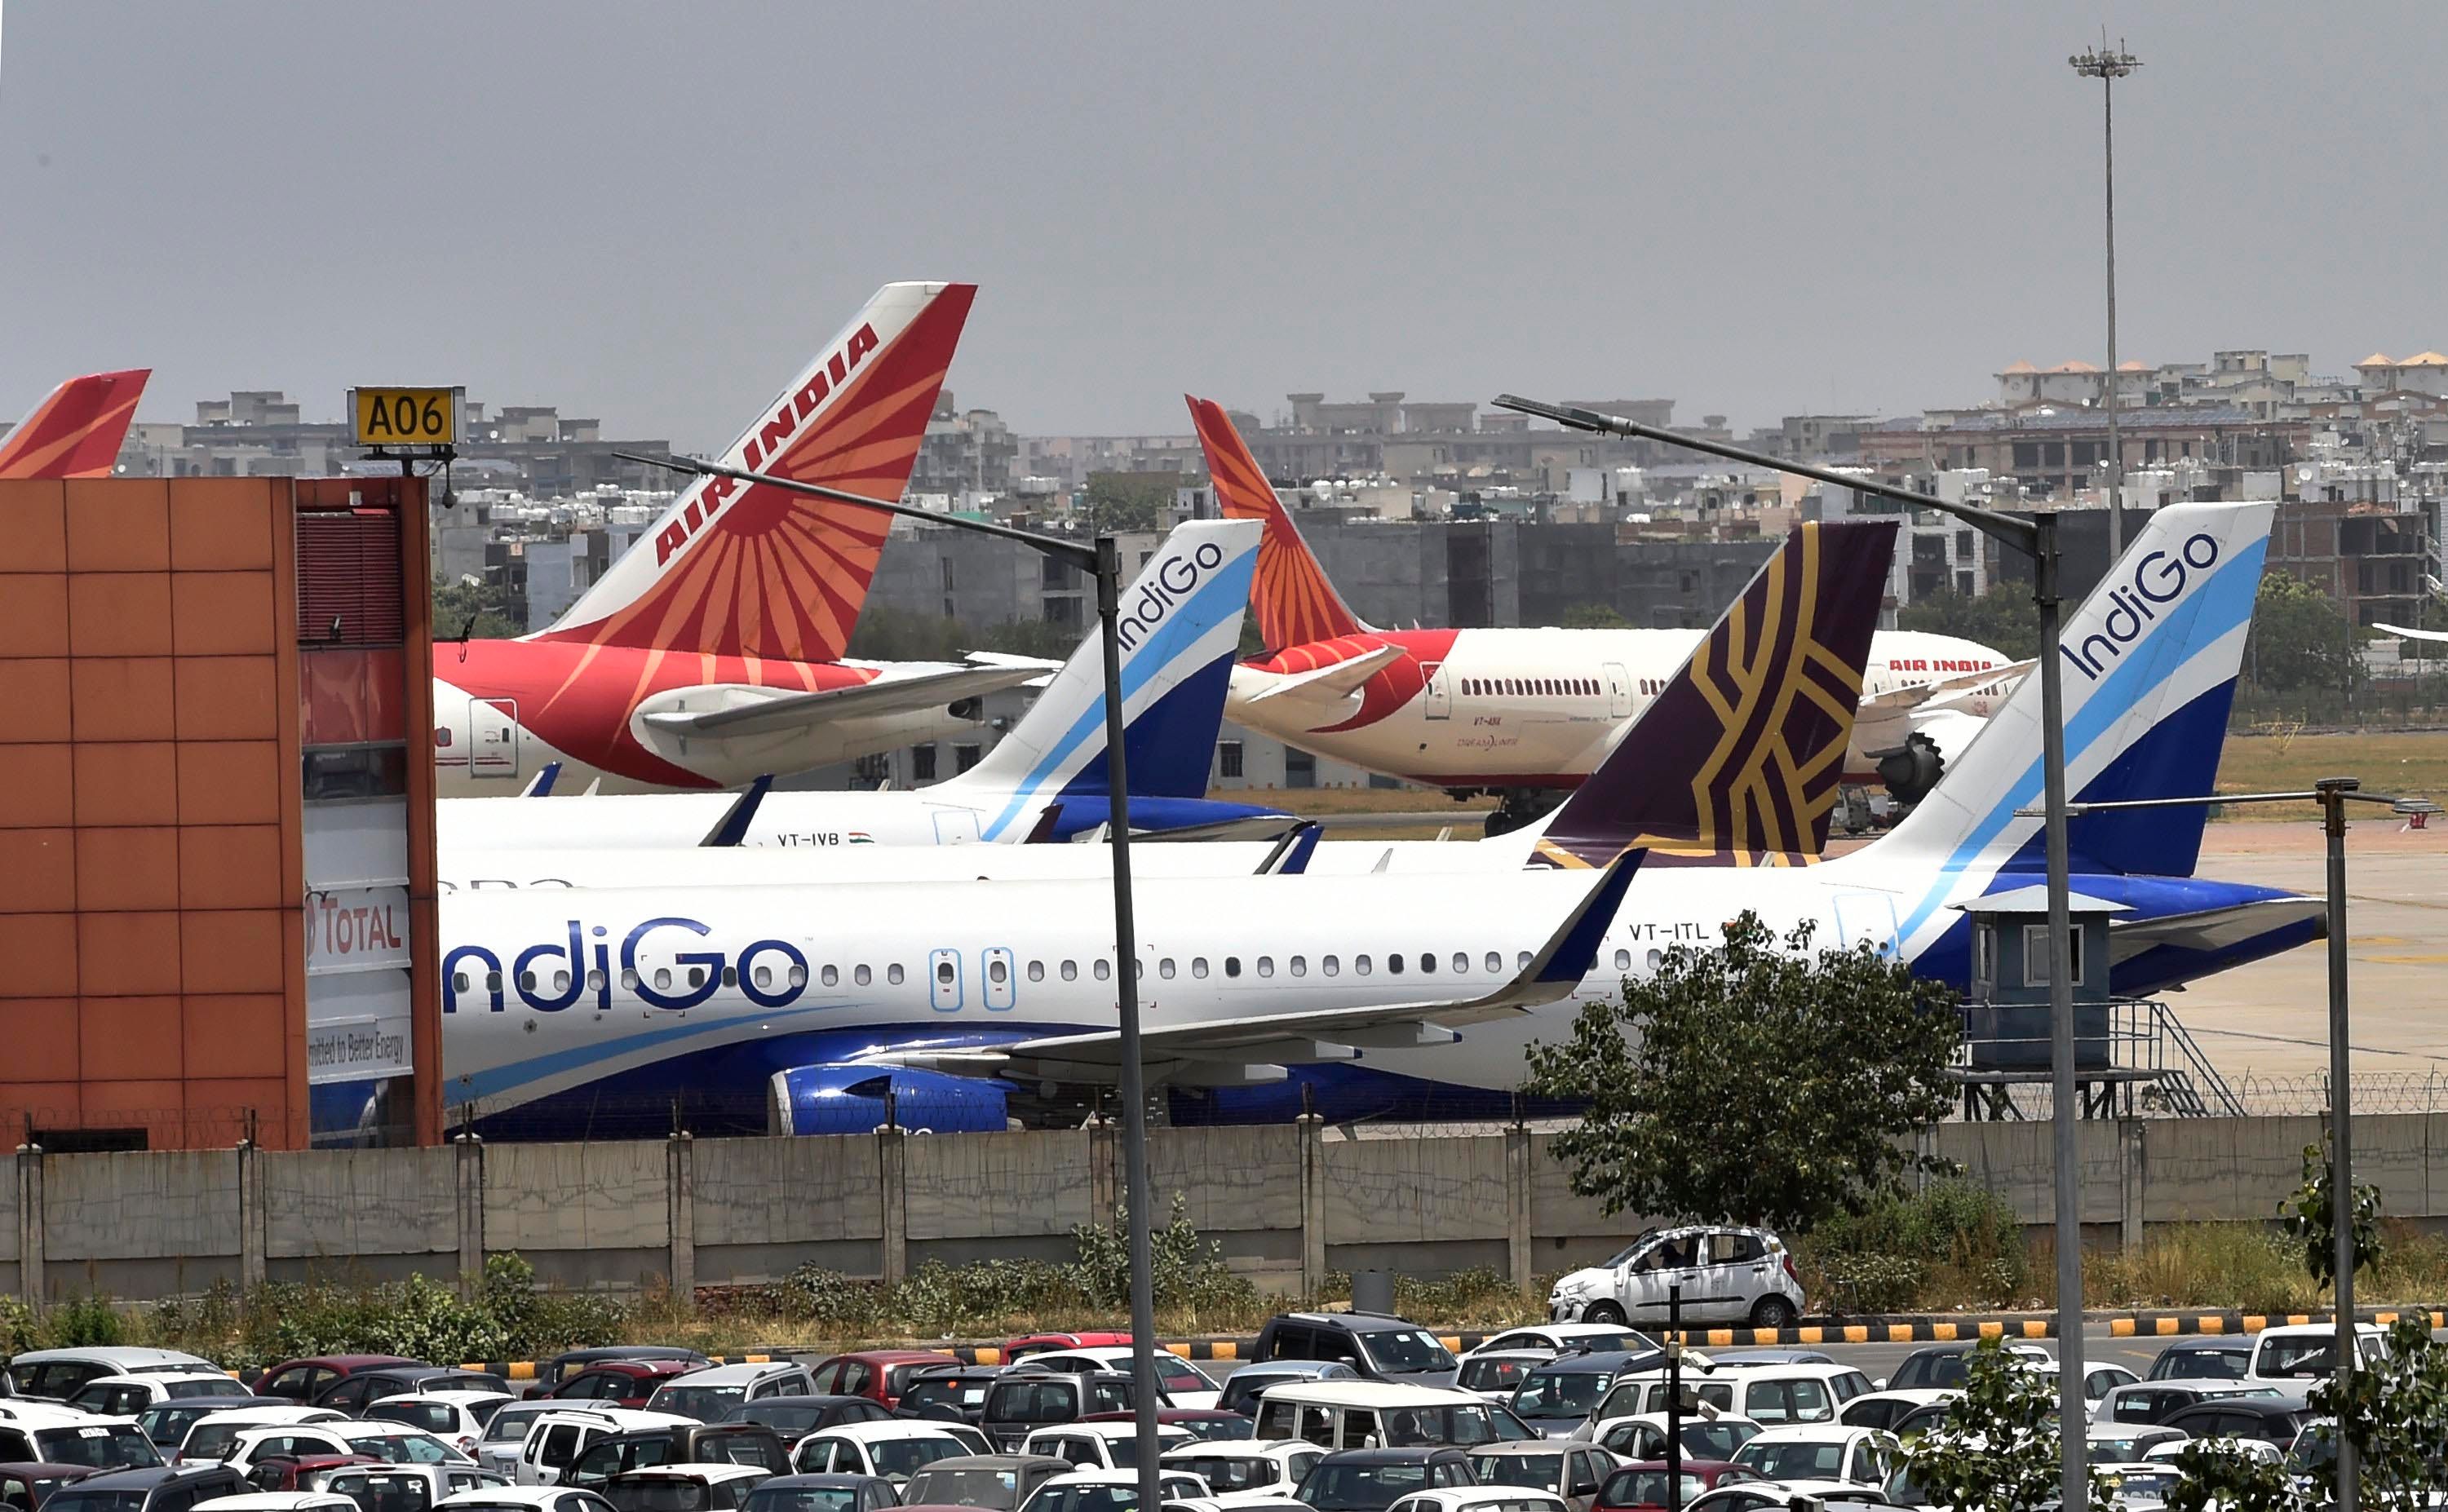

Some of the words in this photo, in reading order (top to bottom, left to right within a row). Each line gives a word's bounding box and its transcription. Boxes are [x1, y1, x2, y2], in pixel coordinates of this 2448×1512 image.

[368, 396, 443, 435] A06
[656, 475, 739, 568] AIR
[743, 322, 879, 472] INDIA
[2059, 533, 2219, 681] IndiGo
[1889, 660, 1928, 671] AIR
[1933, 660, 1992, 672] INDIA
[777, 833, 839, 847] VT-IVB
[320, 898, 401, 954] TOTAL
[1629, 923, 1710, 940] VT-ITL
[337, 1035, 347, 1063] to
[348, 1033, 374, 1062] Better
[376, 1031, 404, 1064] Energy
